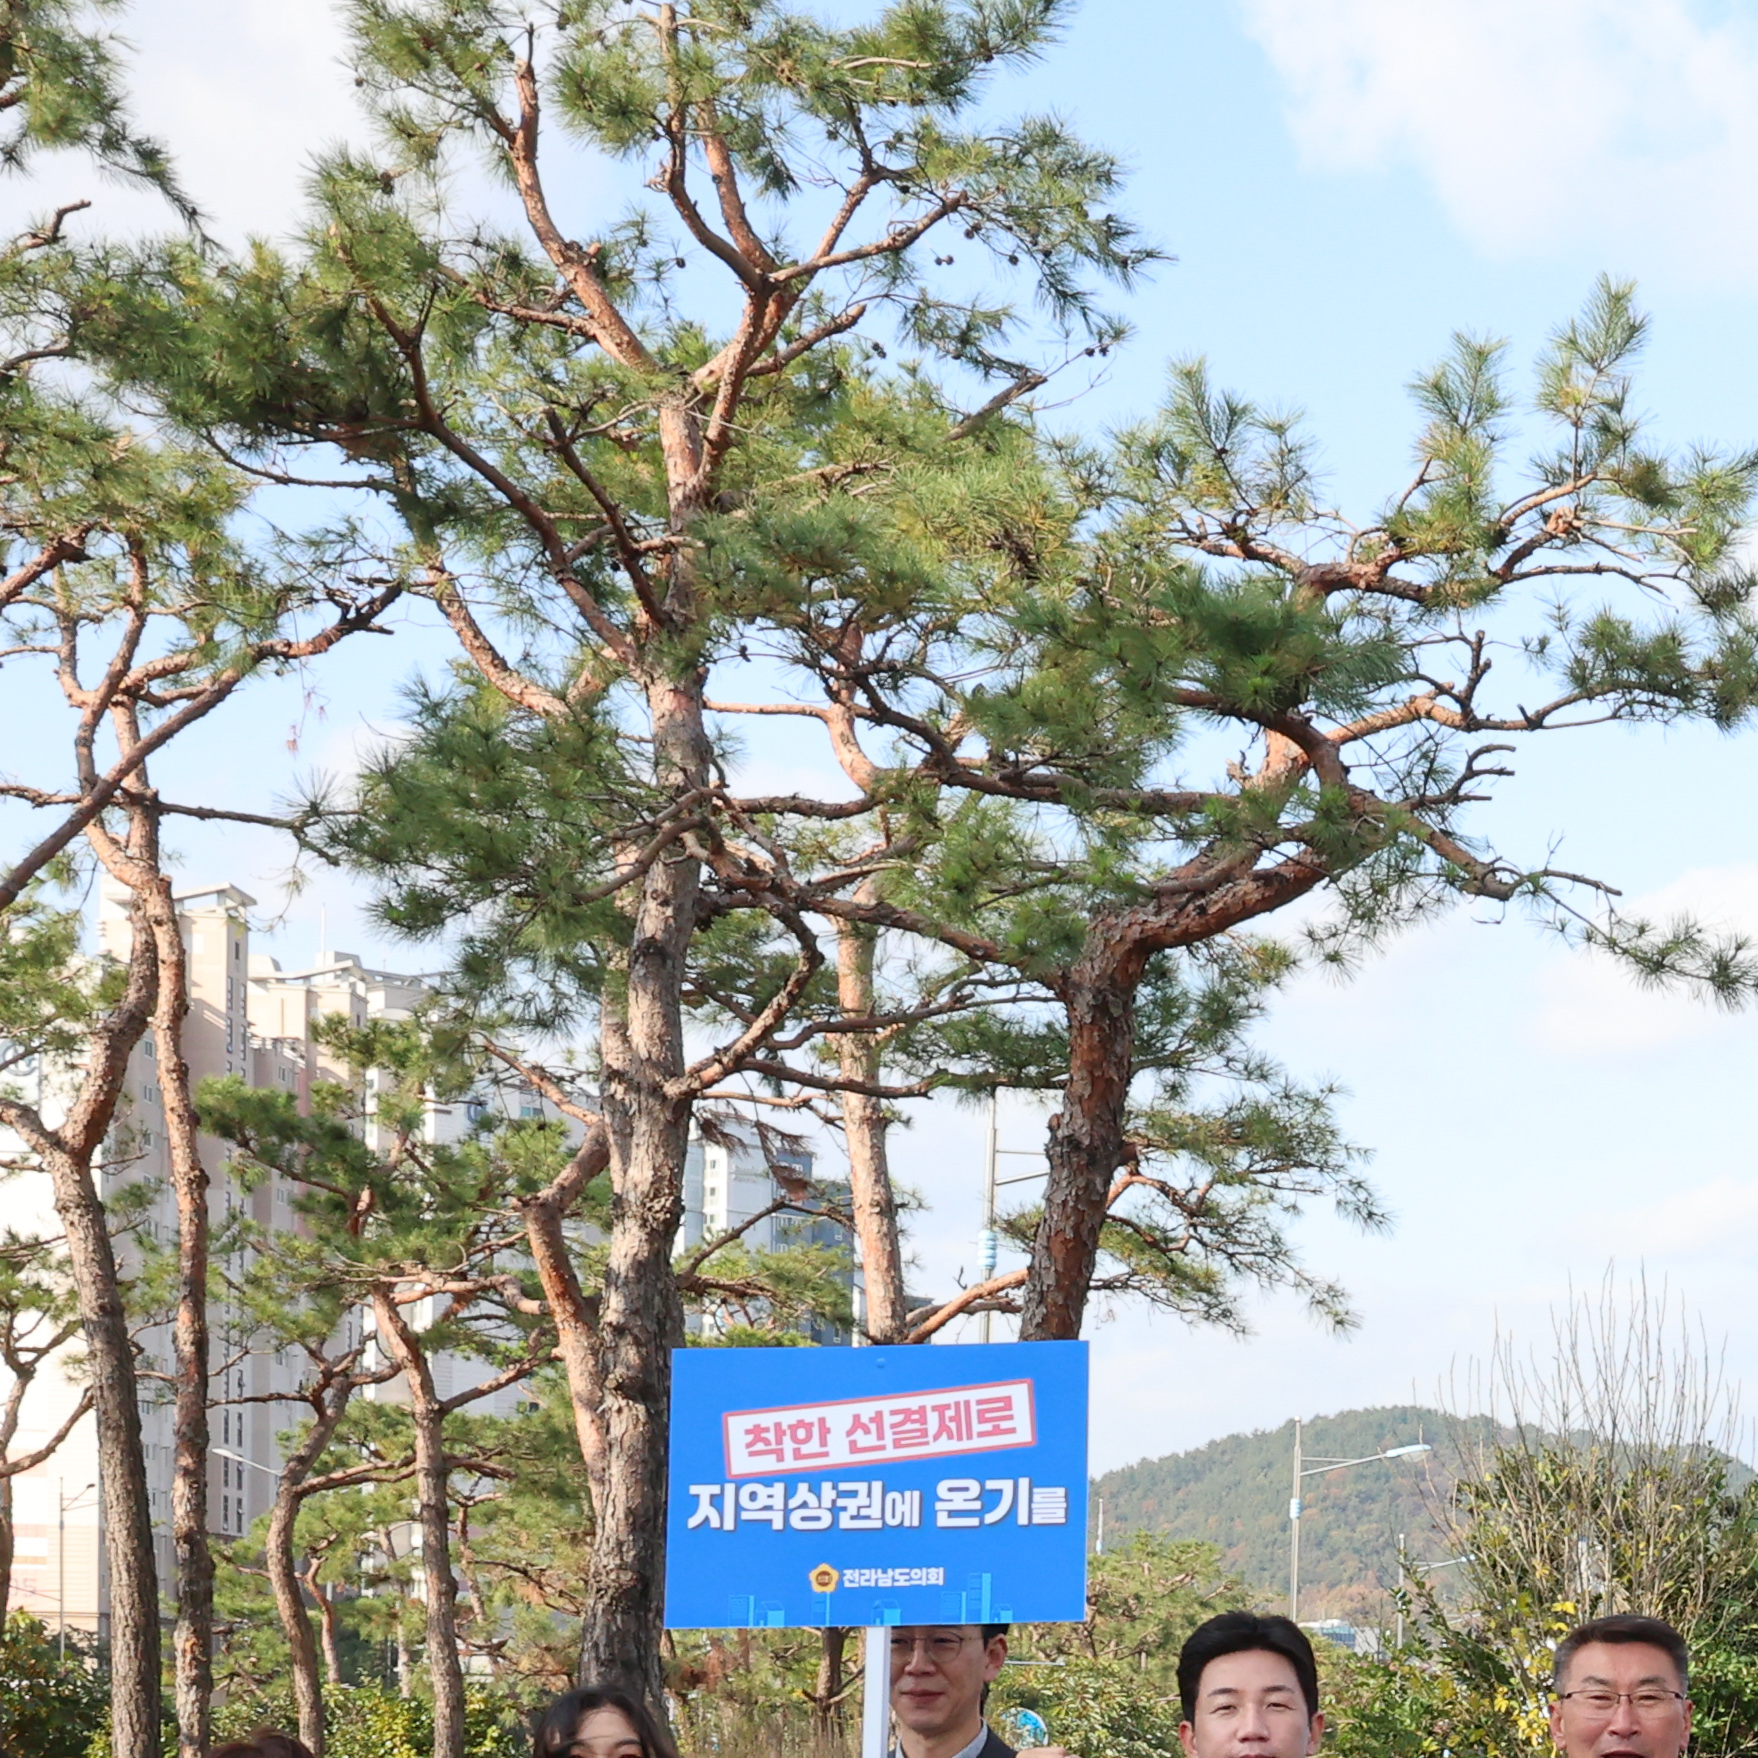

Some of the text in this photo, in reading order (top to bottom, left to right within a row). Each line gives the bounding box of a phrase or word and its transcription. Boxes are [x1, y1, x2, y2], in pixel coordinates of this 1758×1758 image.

[744, 1394, 1018, 1463] 착한 선결제로
[687, 1476, 1068, 1531] 지역상권에 온기를
[843, 1565, 945, 1588] 전라남도의회
